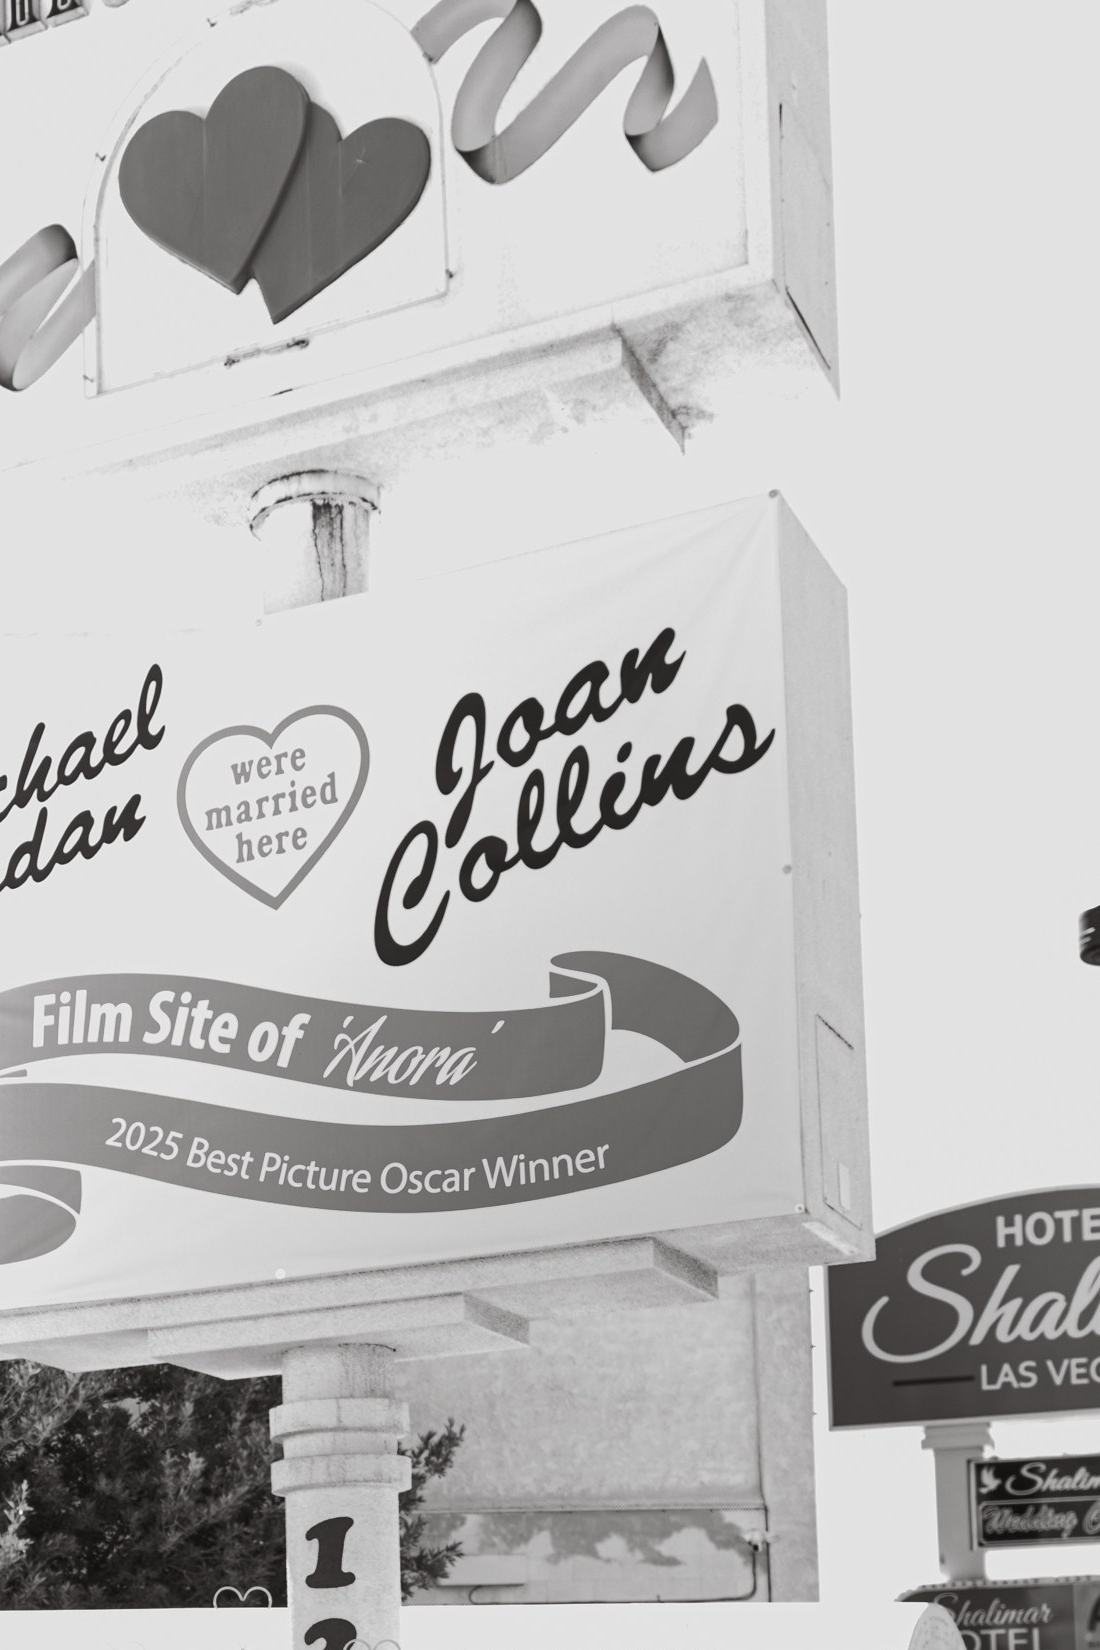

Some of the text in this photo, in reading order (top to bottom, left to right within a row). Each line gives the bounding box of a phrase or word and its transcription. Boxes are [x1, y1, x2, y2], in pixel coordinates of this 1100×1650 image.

[231, 748, 306, 785] were
[435, 627, 686, 848] Joan
[205, 771, 338, 831] married
[236, 827, 307, 863] here
[374, 704, 775, 966] Collins
[32, 990, 132, 1047] Film
[142, 990, 239, 1054] Site
[248, 1013, 311, 1068] of
[105, 1117, 609, 1194] 2025 Best Picture Oscar Winner
[981, 1361, 1037, 1390] LAS
[982, 1503, 1078, 1538] Wedding
